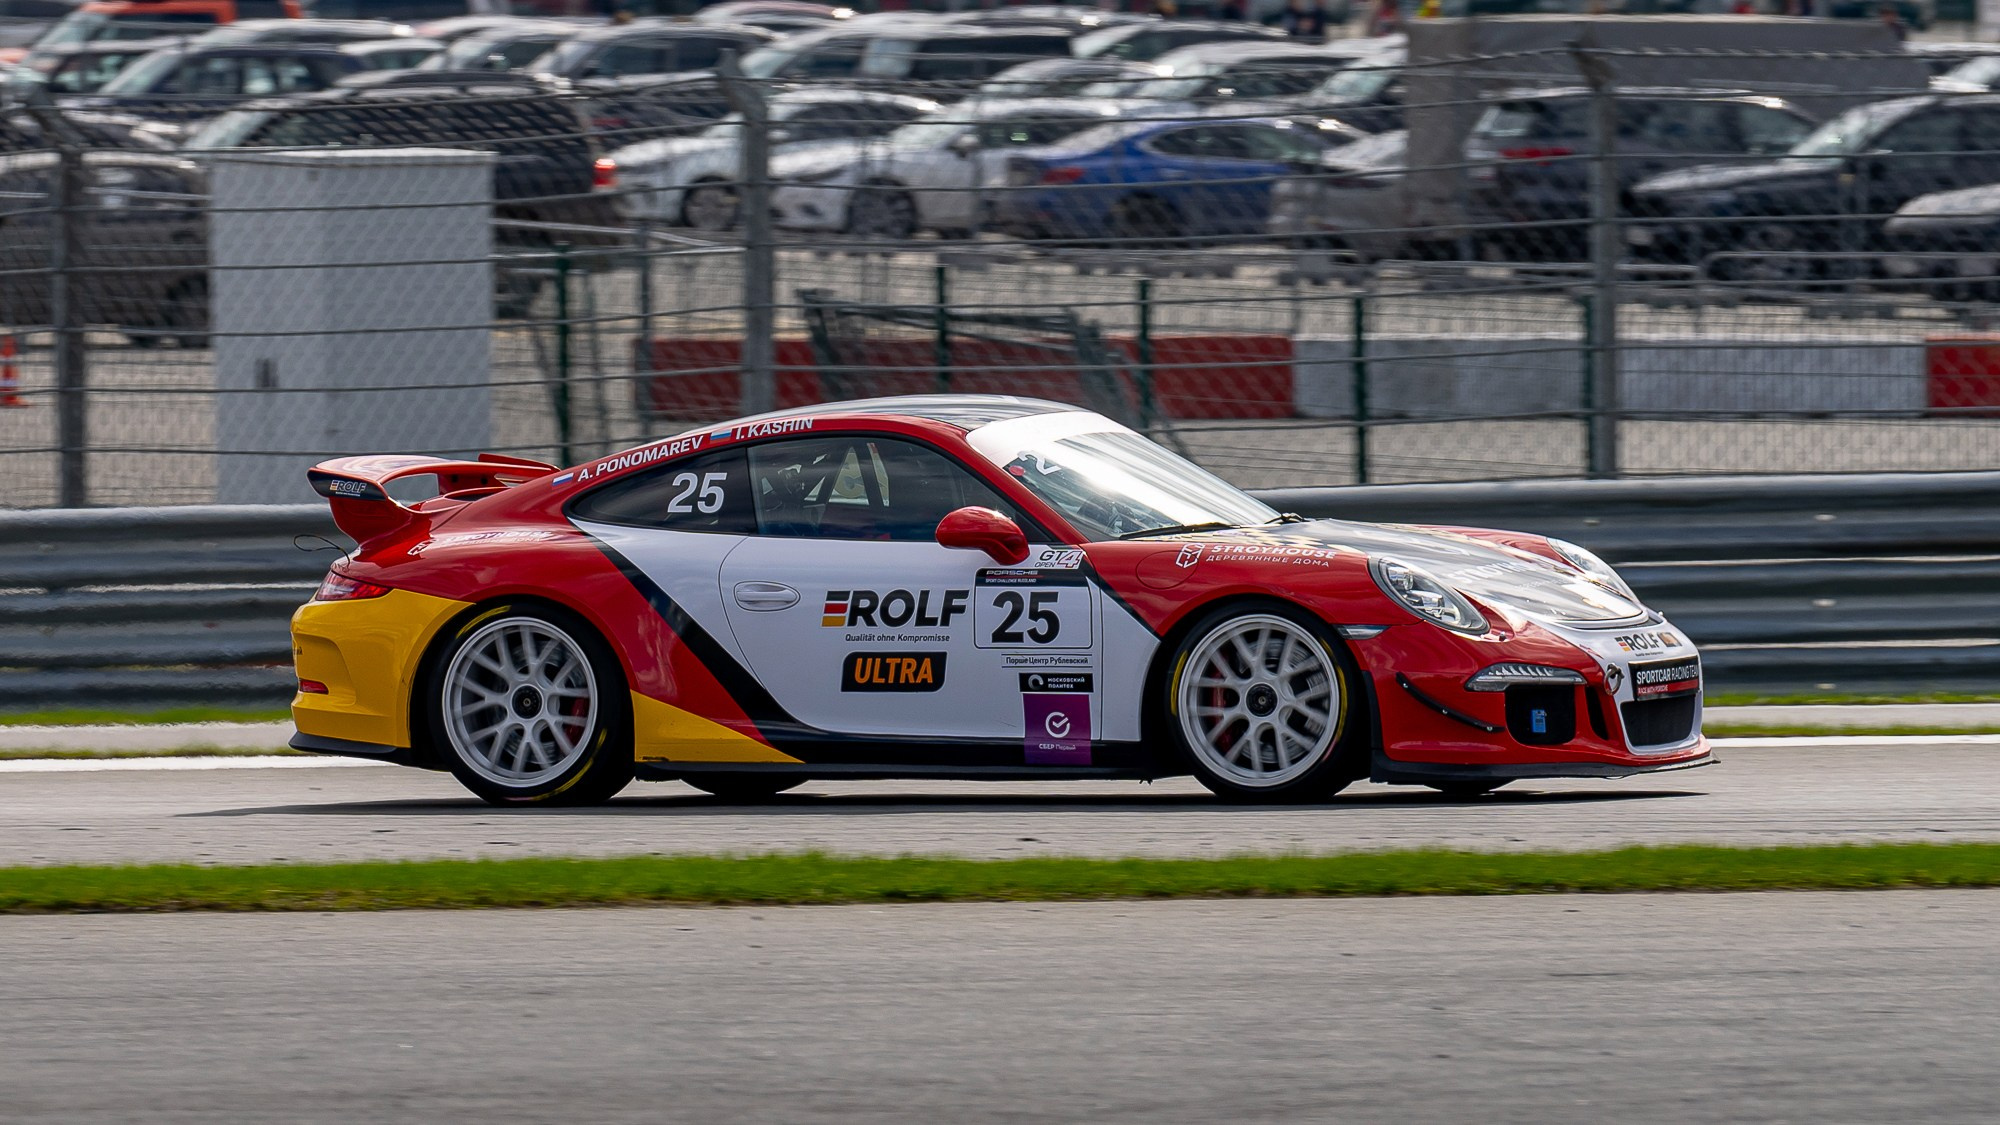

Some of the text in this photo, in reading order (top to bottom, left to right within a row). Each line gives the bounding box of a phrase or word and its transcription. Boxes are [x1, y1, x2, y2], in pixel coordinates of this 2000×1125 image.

[748, 418, 815, 440] KASHIN
[577, 436, 704, 482] A. PONOMAREV
[336, 481, 368, 493] ROLF
[667, 472, 728, 514] 25
[1039, 550, 1084, 568] GT4
[1206, 554, 1330, 568] ДЕРЕВЯННЫЕ ДОМА
[1211, 545, 1338, 560] STROYHOUSE
[846, 589, 970, 627] ROLF
[991, 590, 1060, 644] 25
[845, 633, 951, 643] Qualität ohne Kompromisse
[1622, 633, 1660, 651] ROLF
[1029, 656, 1049, 665] Центр
[854, 657, 933, 684] ULTRA
[1636, 668, 1671, 685] SPORTCAR
